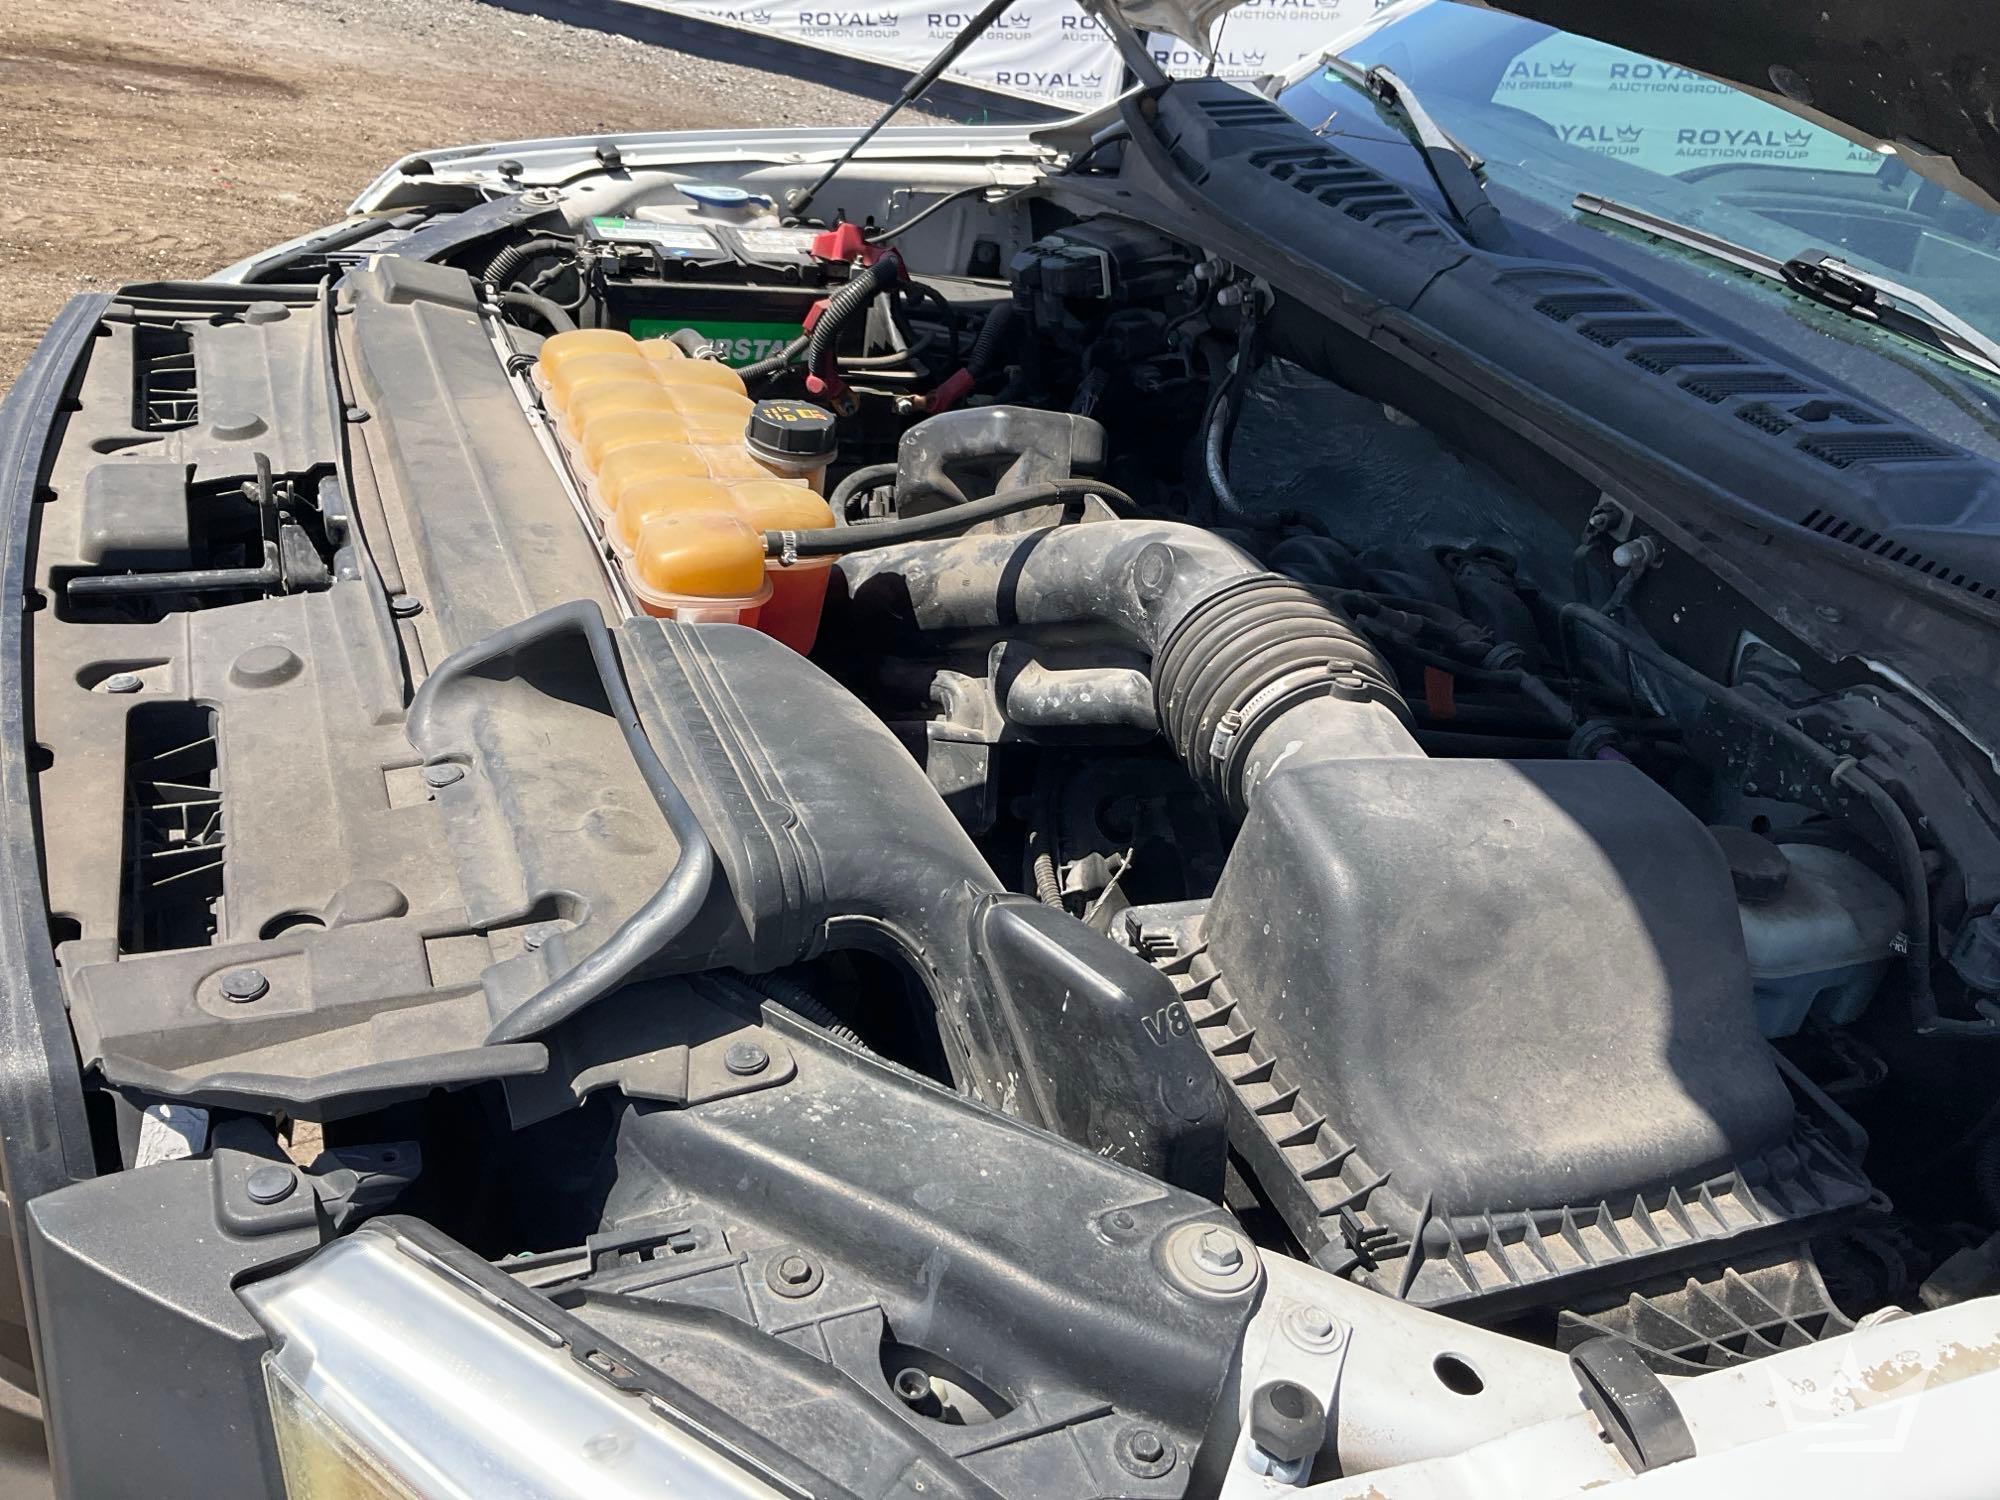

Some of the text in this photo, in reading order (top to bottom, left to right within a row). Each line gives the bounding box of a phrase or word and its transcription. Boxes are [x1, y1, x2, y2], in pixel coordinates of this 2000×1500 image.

[799, 12, 877, 26] ROYAL
[1289, 12, 1340, 21] GROUP
[800, 27, 900, 39] AUCTION GROUP
[987, 32, 1032, 41] GROUP
[1610, 63, 1707, 80] ROYA
[997, 72, 1079, 87] ROYAL
[1519, 81, 1574, 90] GROUP
[1607, 81, 1680, 93] AUCTION
[1056, 89, 1103, 100] GROUP
[1677, 128, 1782, 146] ROYAL
[1675, 147, 1809, 160] AUCTION GROUP
[1141, 1002, 1188, 1047] V8
